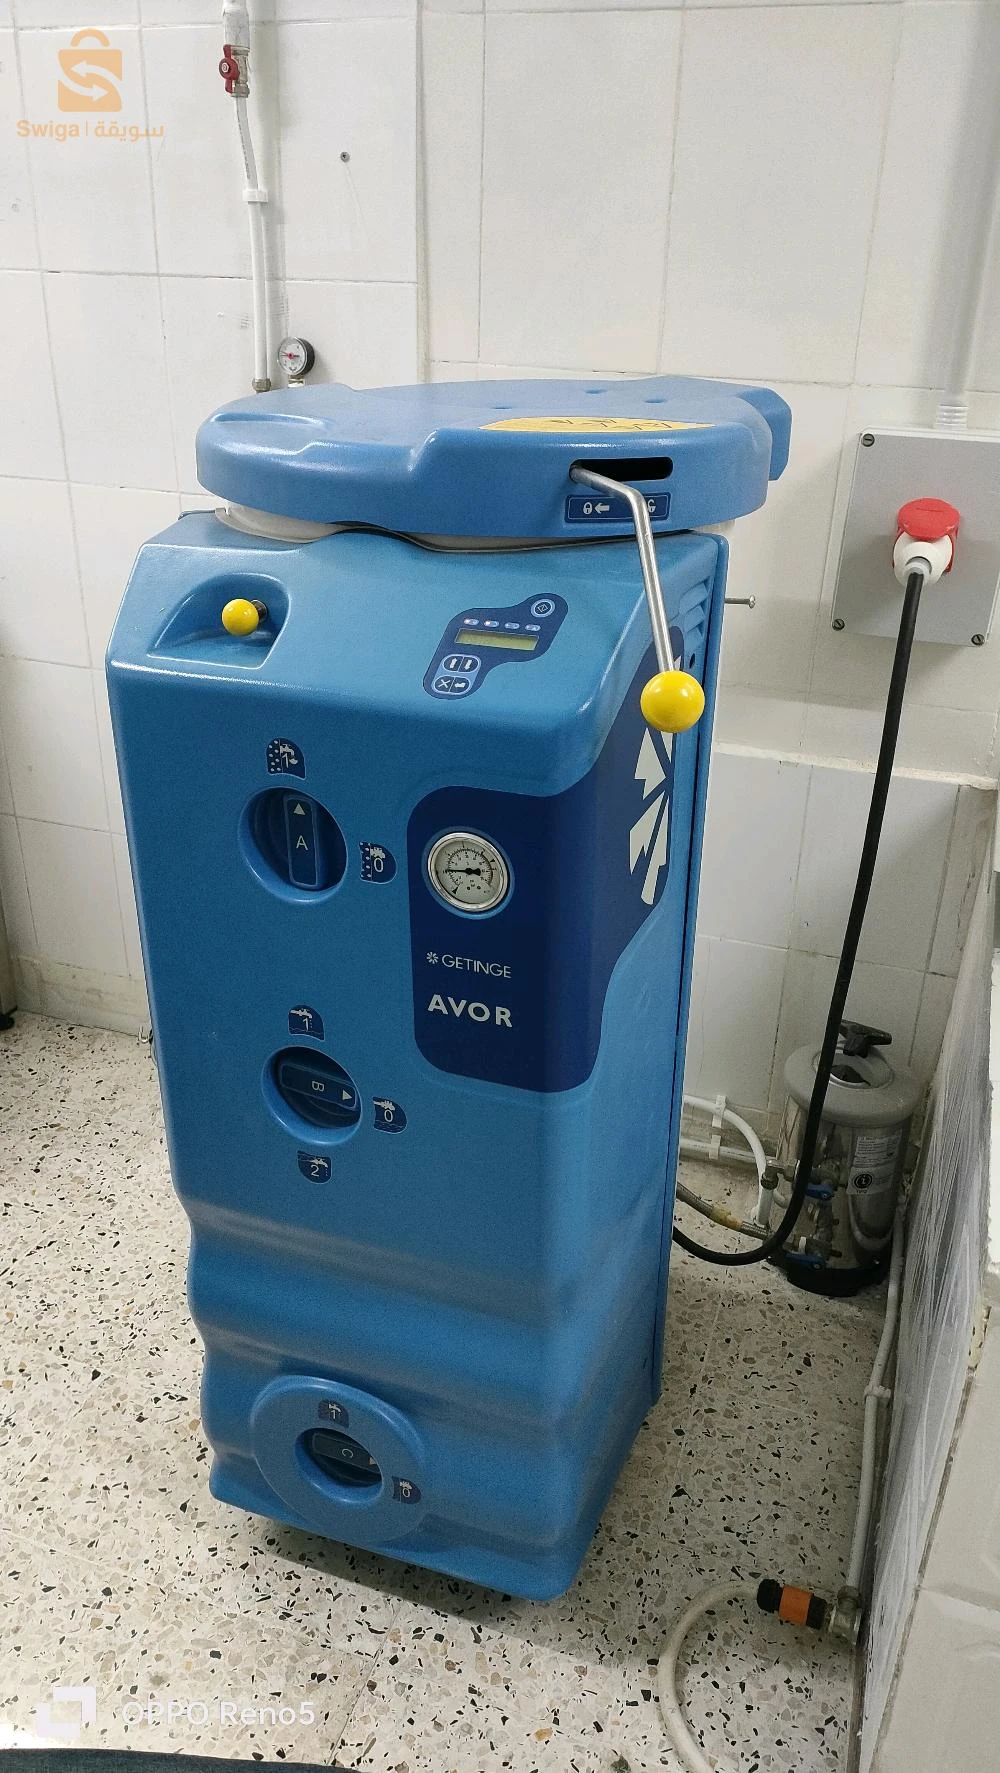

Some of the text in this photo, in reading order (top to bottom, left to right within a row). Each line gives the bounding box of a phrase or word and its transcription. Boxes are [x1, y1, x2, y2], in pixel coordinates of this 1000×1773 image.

[282, 752, 289, 768] 1
[296, 835, 308, 850] A
[441, 954, 512, 979] GETINGE
[427, 994, 513, 1028] AVOR
[302, 1017, 309, 1031] 1
[311, 1080, 324, 1092] B
[310, 1164, 320, 1177] 2
